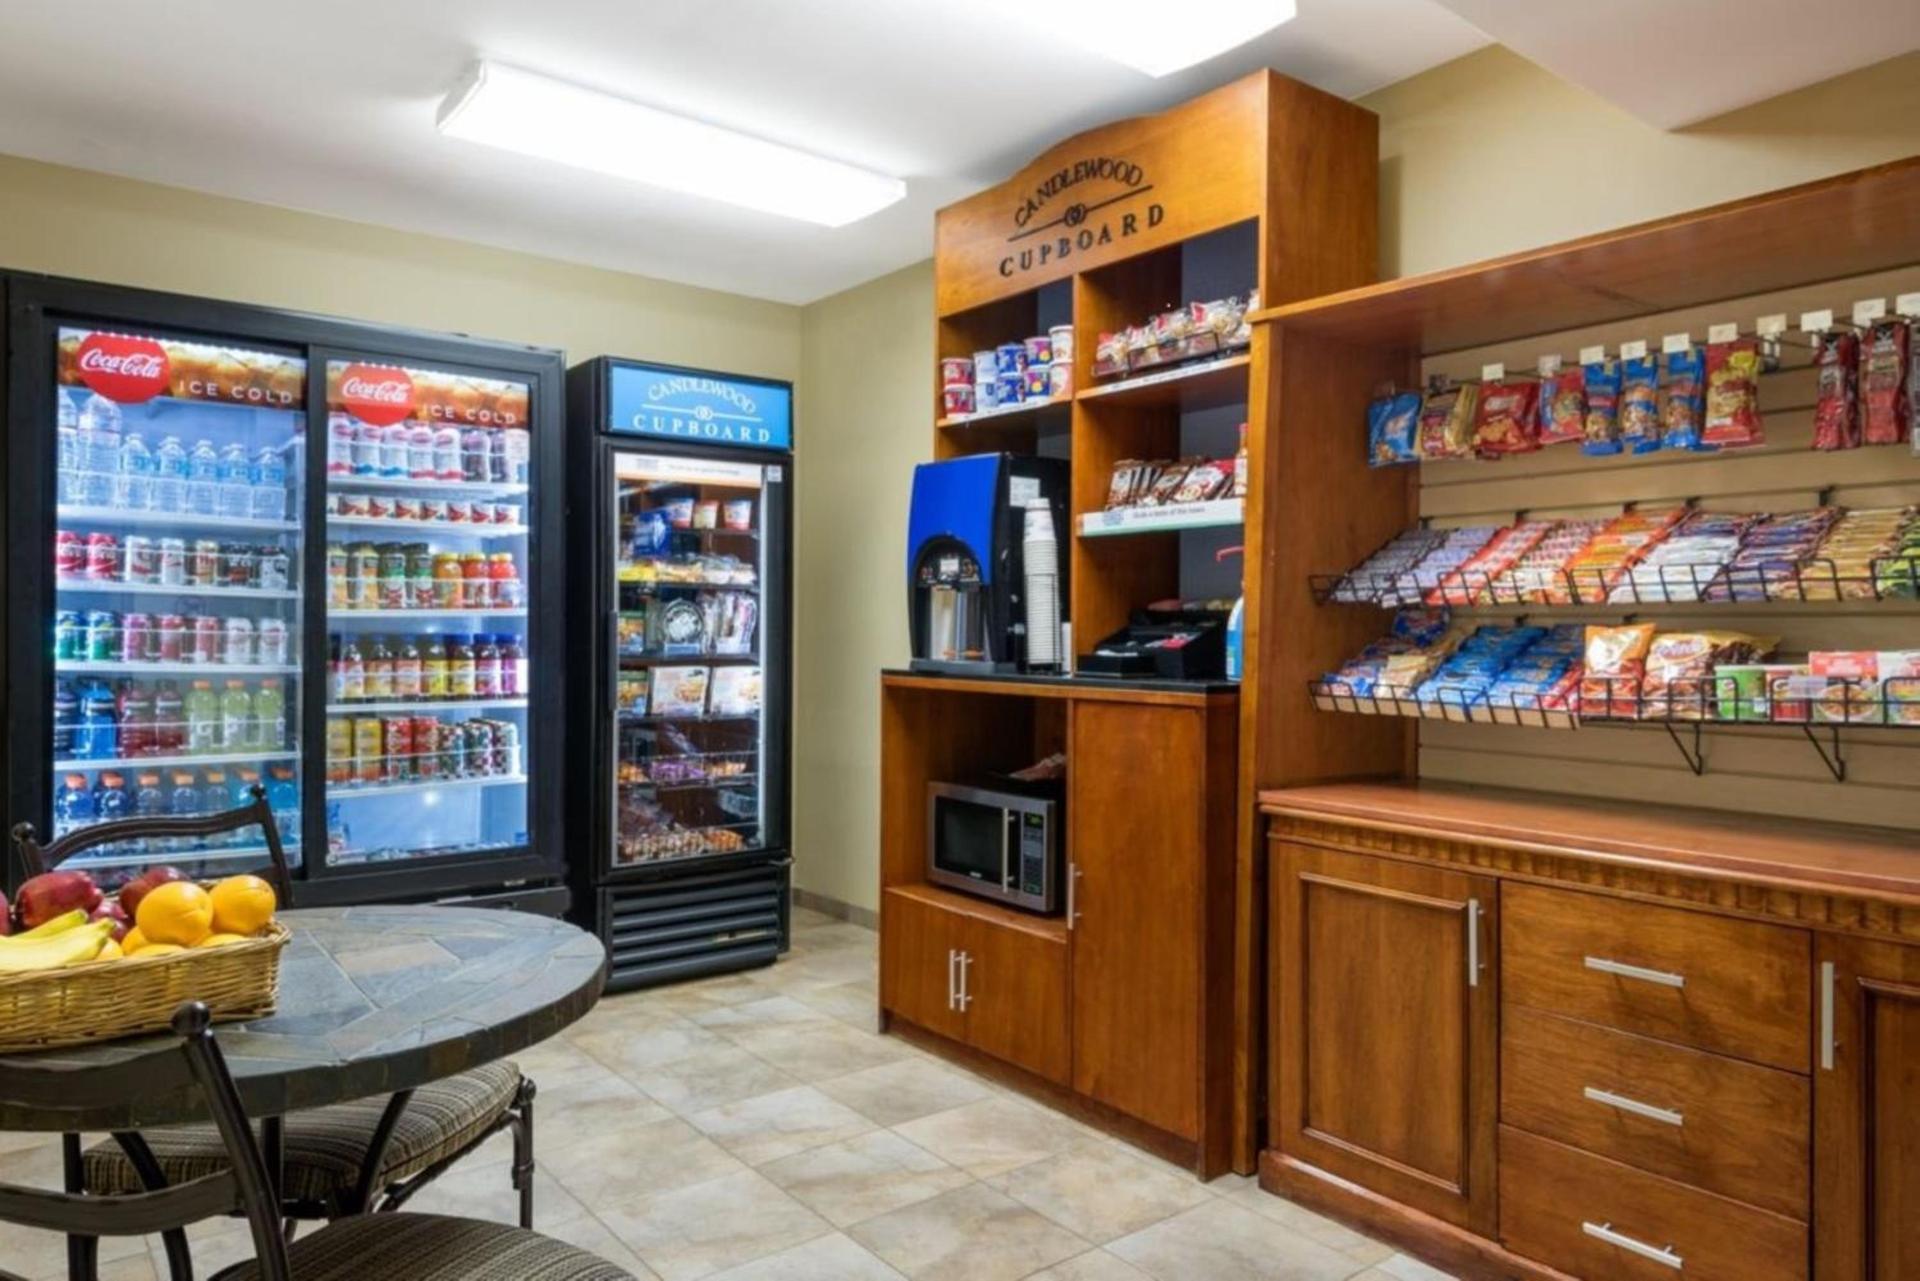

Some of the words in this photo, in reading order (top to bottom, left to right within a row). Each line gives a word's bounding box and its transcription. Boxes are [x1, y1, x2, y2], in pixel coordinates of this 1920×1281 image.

[1014, 156, 1143, 227] CANDLEWOOD
[999, 204, 1164, 277] CUPBOARD
[79, 347, 165, 379] Coca-Cola
[178, 379, 220, 397] ICE
[231, 386, 294, 404] COLD
[342, 376, 411, 405] Coca-Cola
[648, 379, 756, 413] CANDLEWOOD
[422, 403, 455, 420] ICE
[466, 408, 518, 425] COLD
[633, 415, 770, 442] CUPBOARD
